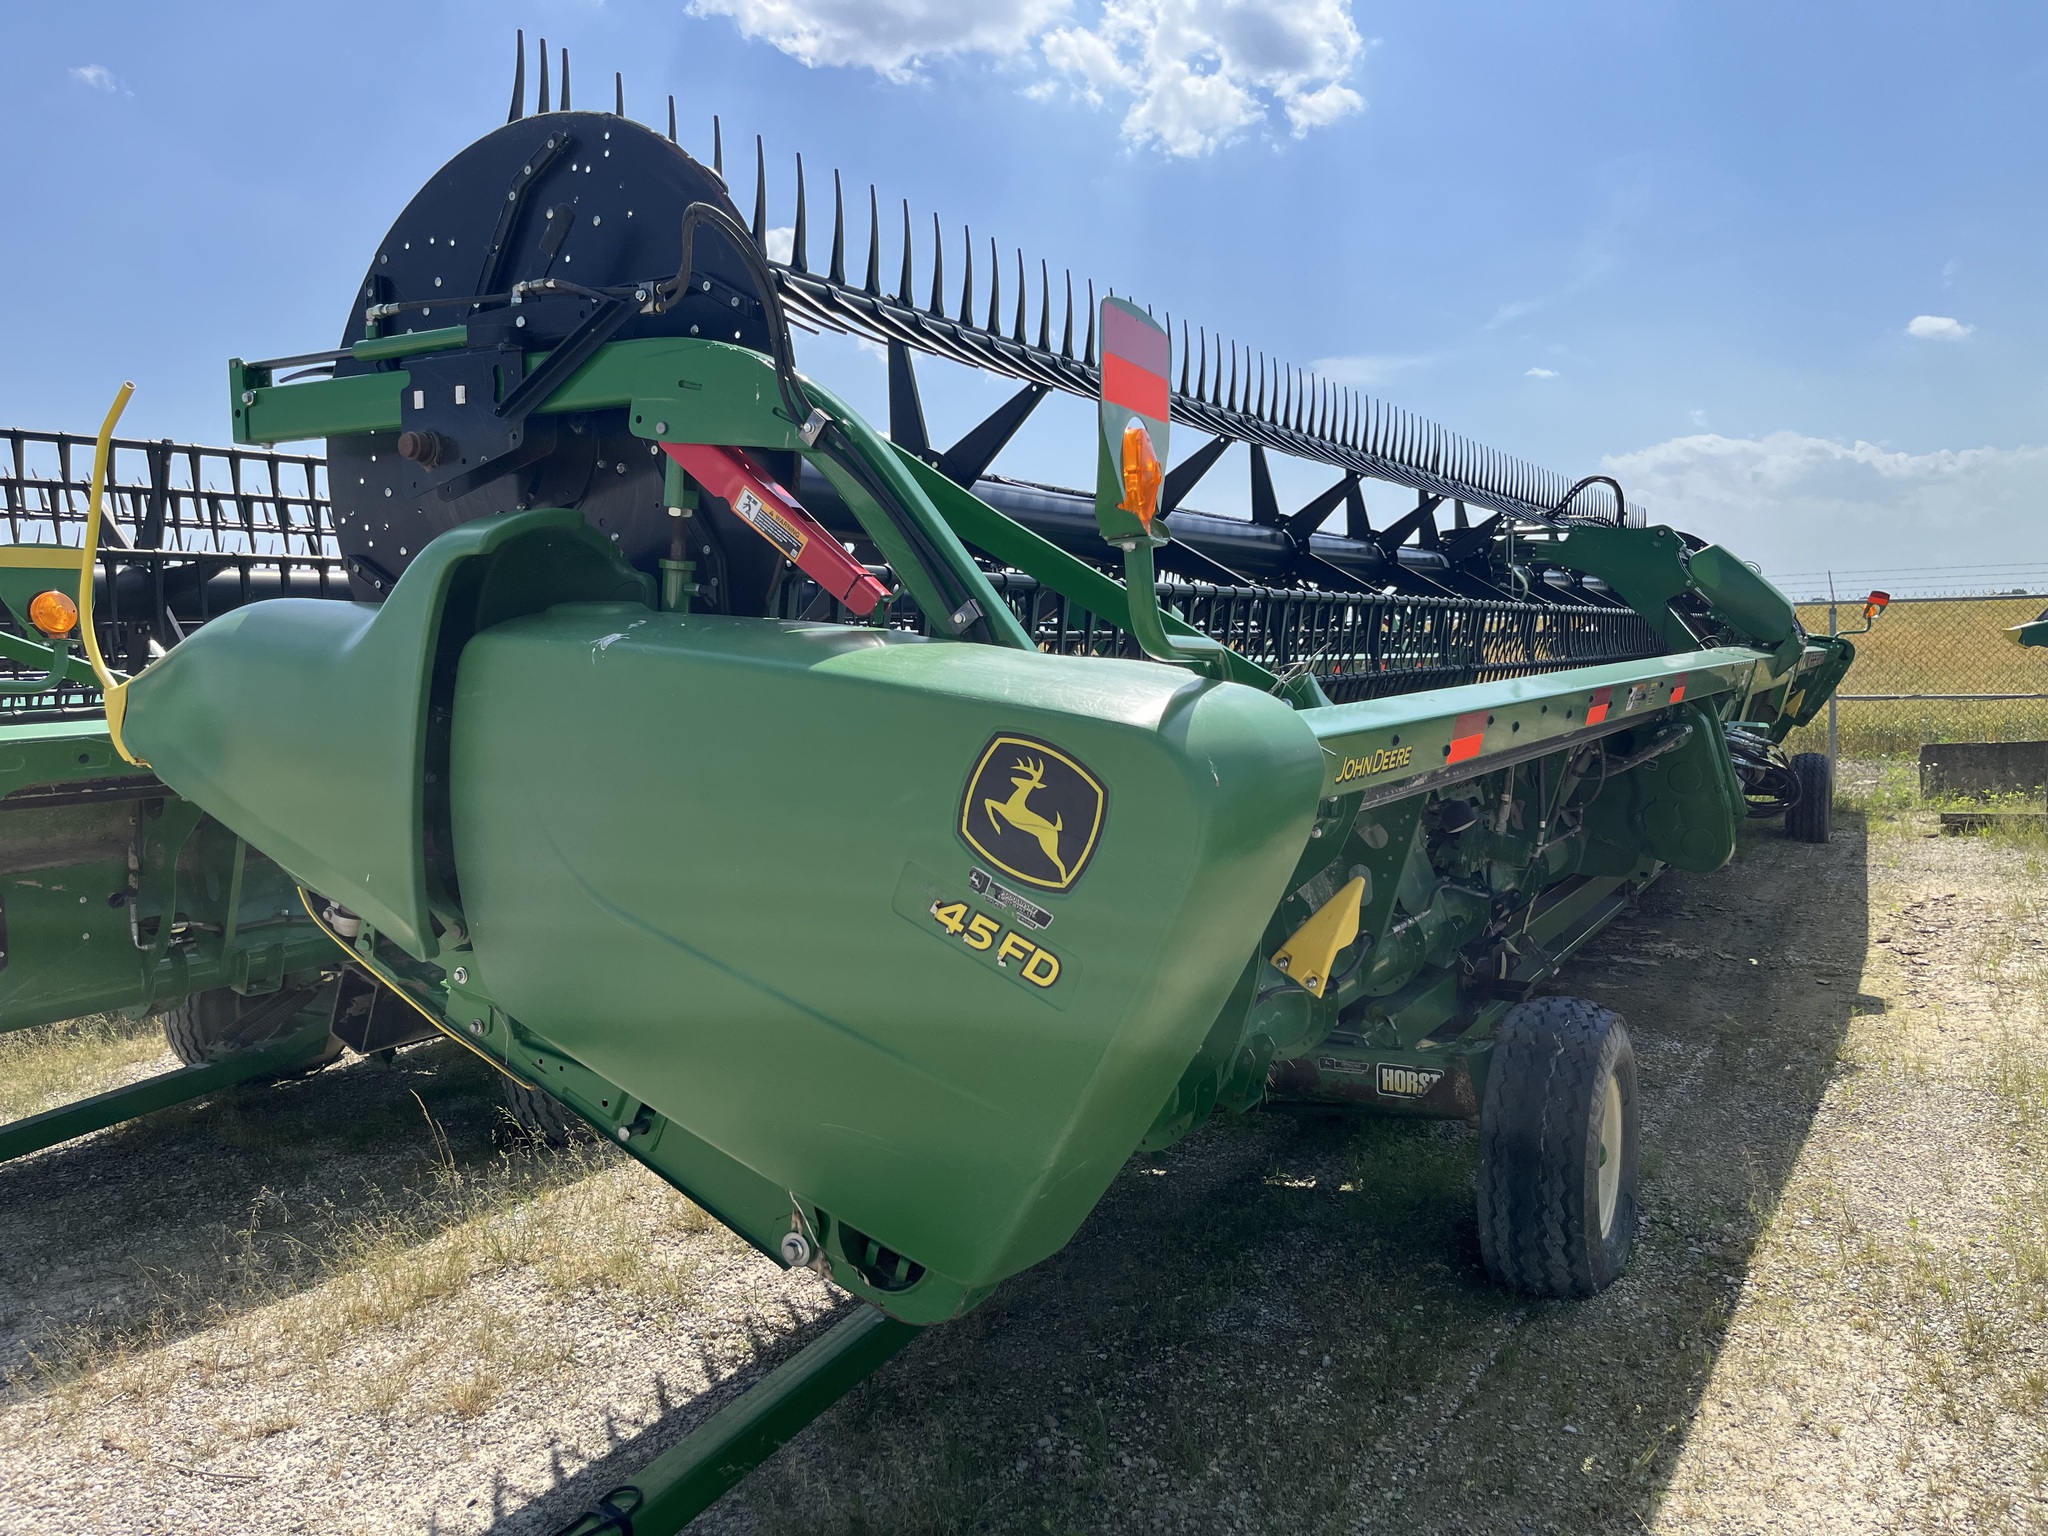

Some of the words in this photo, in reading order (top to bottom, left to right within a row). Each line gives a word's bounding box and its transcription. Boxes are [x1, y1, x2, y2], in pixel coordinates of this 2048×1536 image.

[775, 514, 801, 539] WARNING
[1335, 755, 1374, 784] JOHN
[1371, 744, 1413, 773] DEERE
